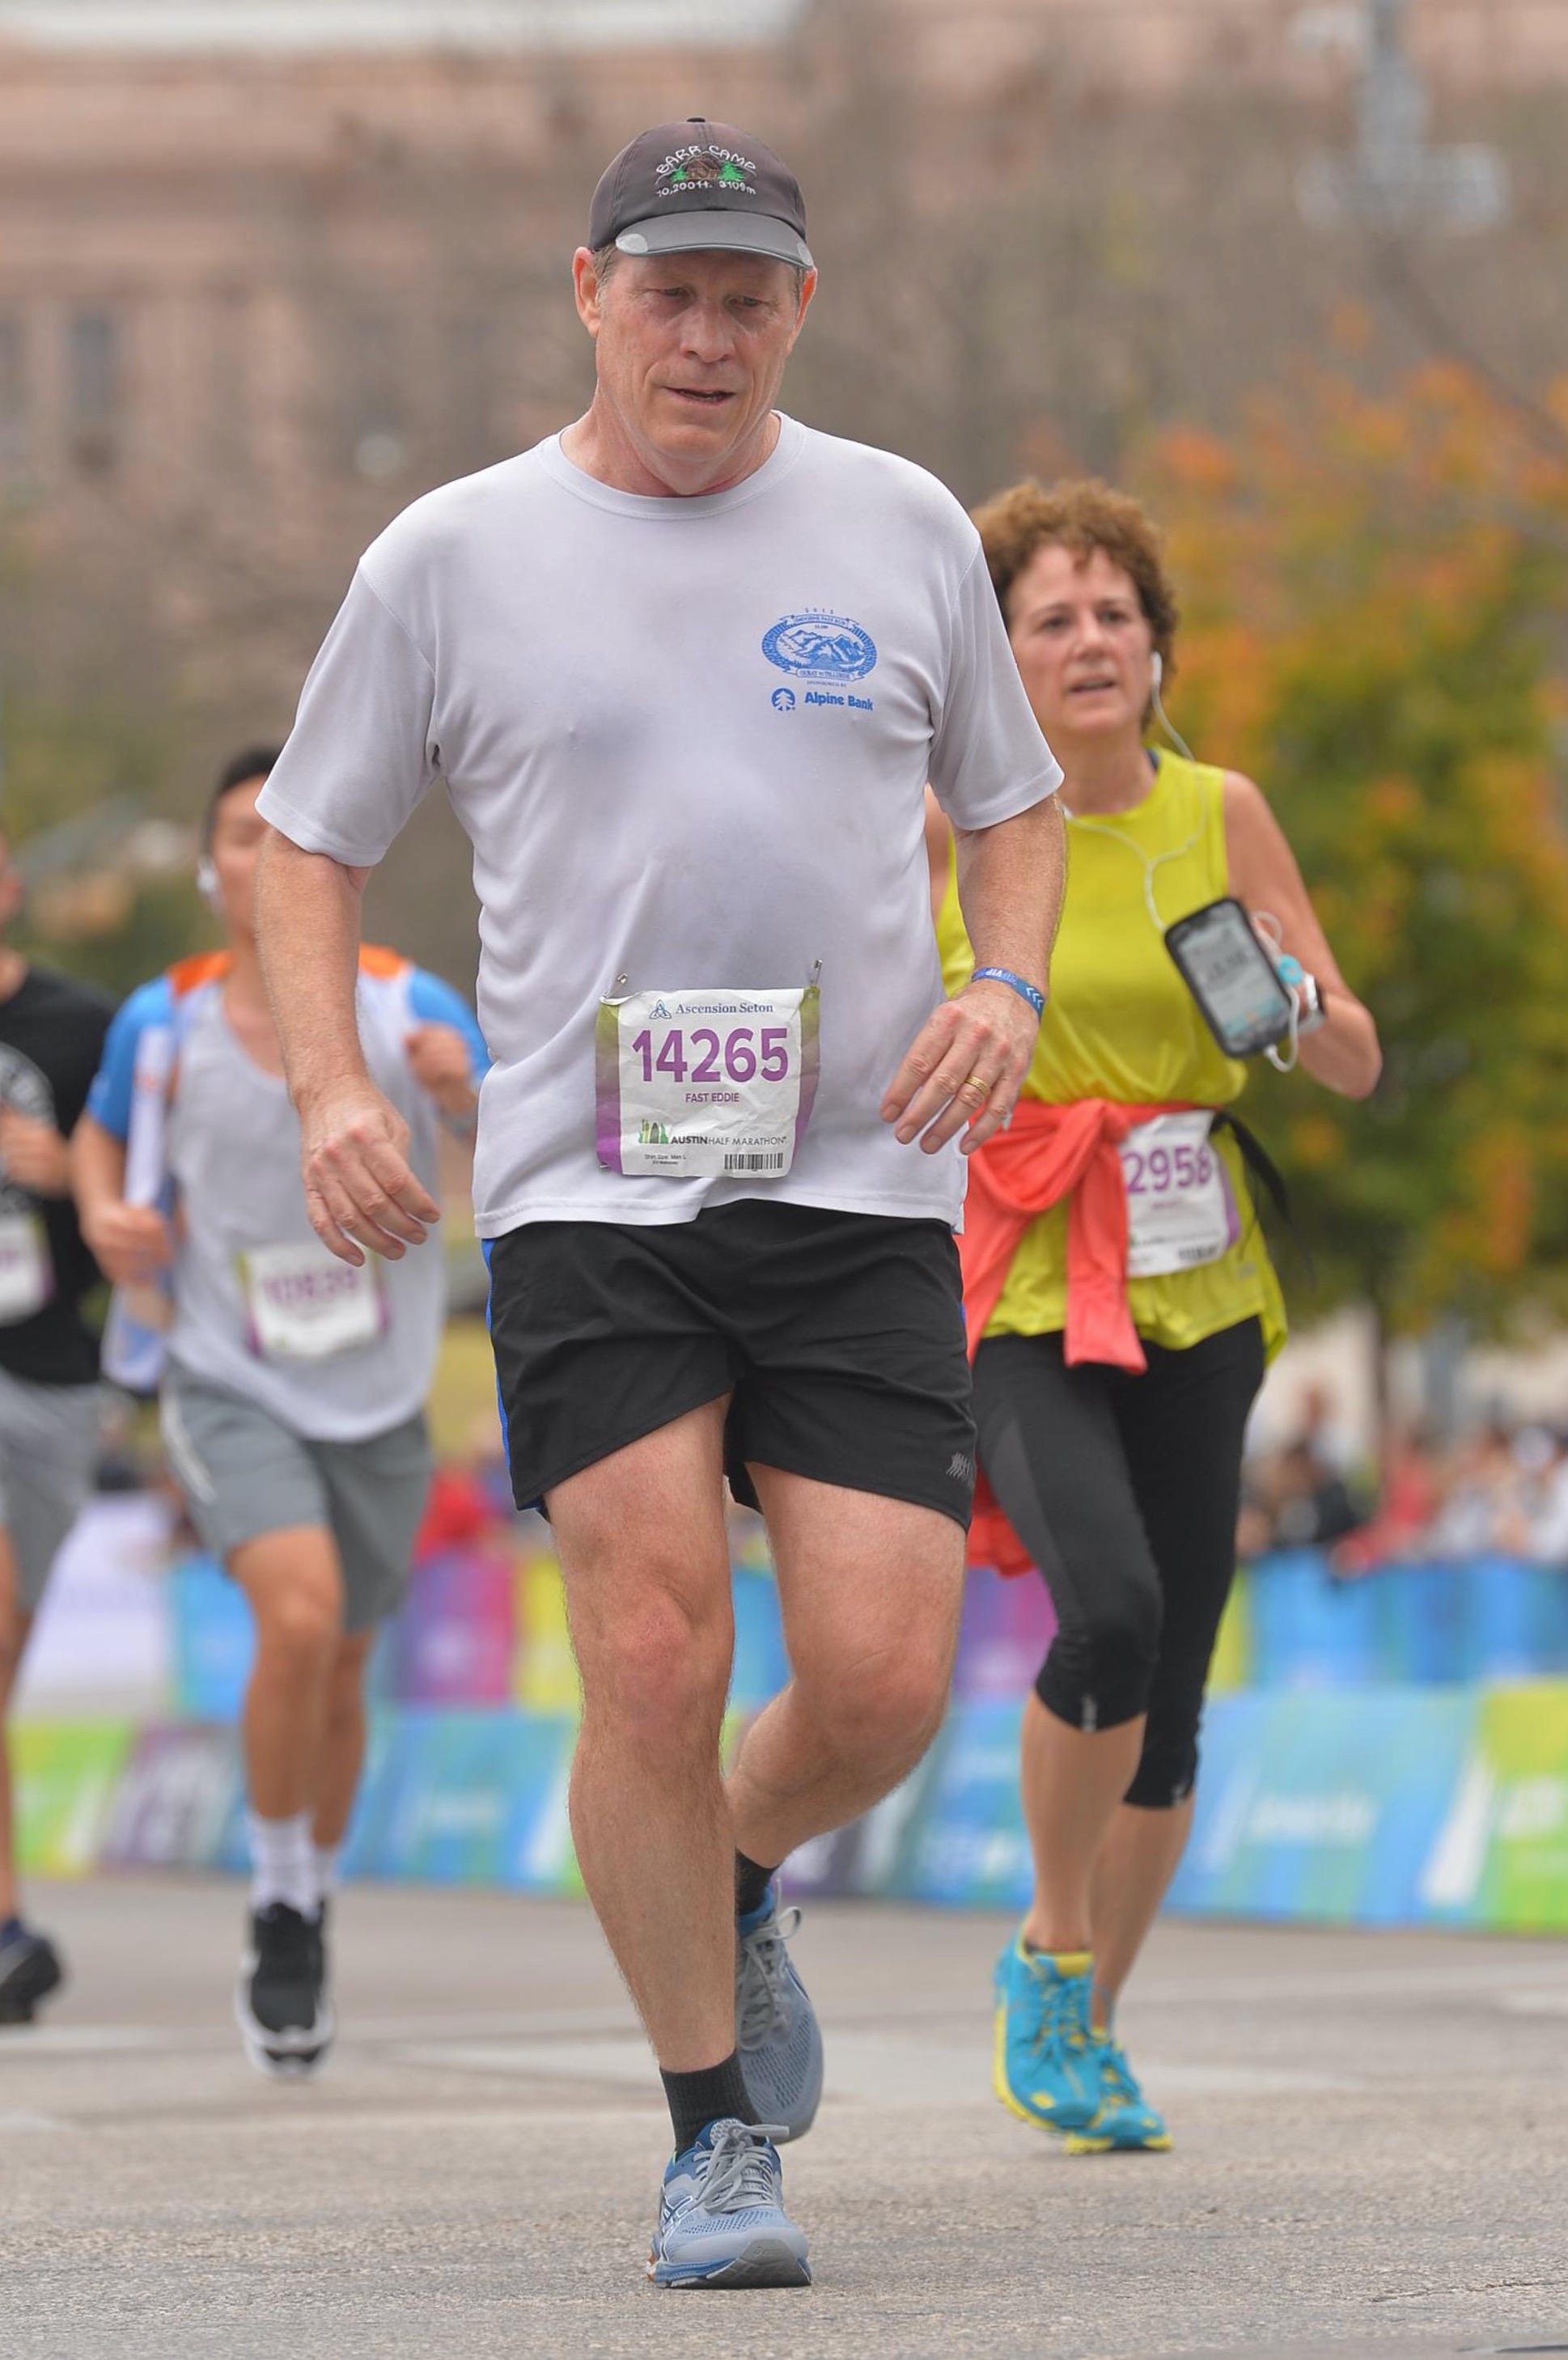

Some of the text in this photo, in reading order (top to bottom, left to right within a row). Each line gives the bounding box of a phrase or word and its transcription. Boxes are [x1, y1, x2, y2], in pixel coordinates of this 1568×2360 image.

[656, 145, 756, 174] BARR CAMP
[804, 692, 874, 711] Alpine Bank
[985, 968, 1003, 977] VIP
[676, 1002, 773, 1015] Ascension Seton
[632, 1027, 789, 1083] 14265
[685, 1092, 740, 1103] FAST EDDIE
